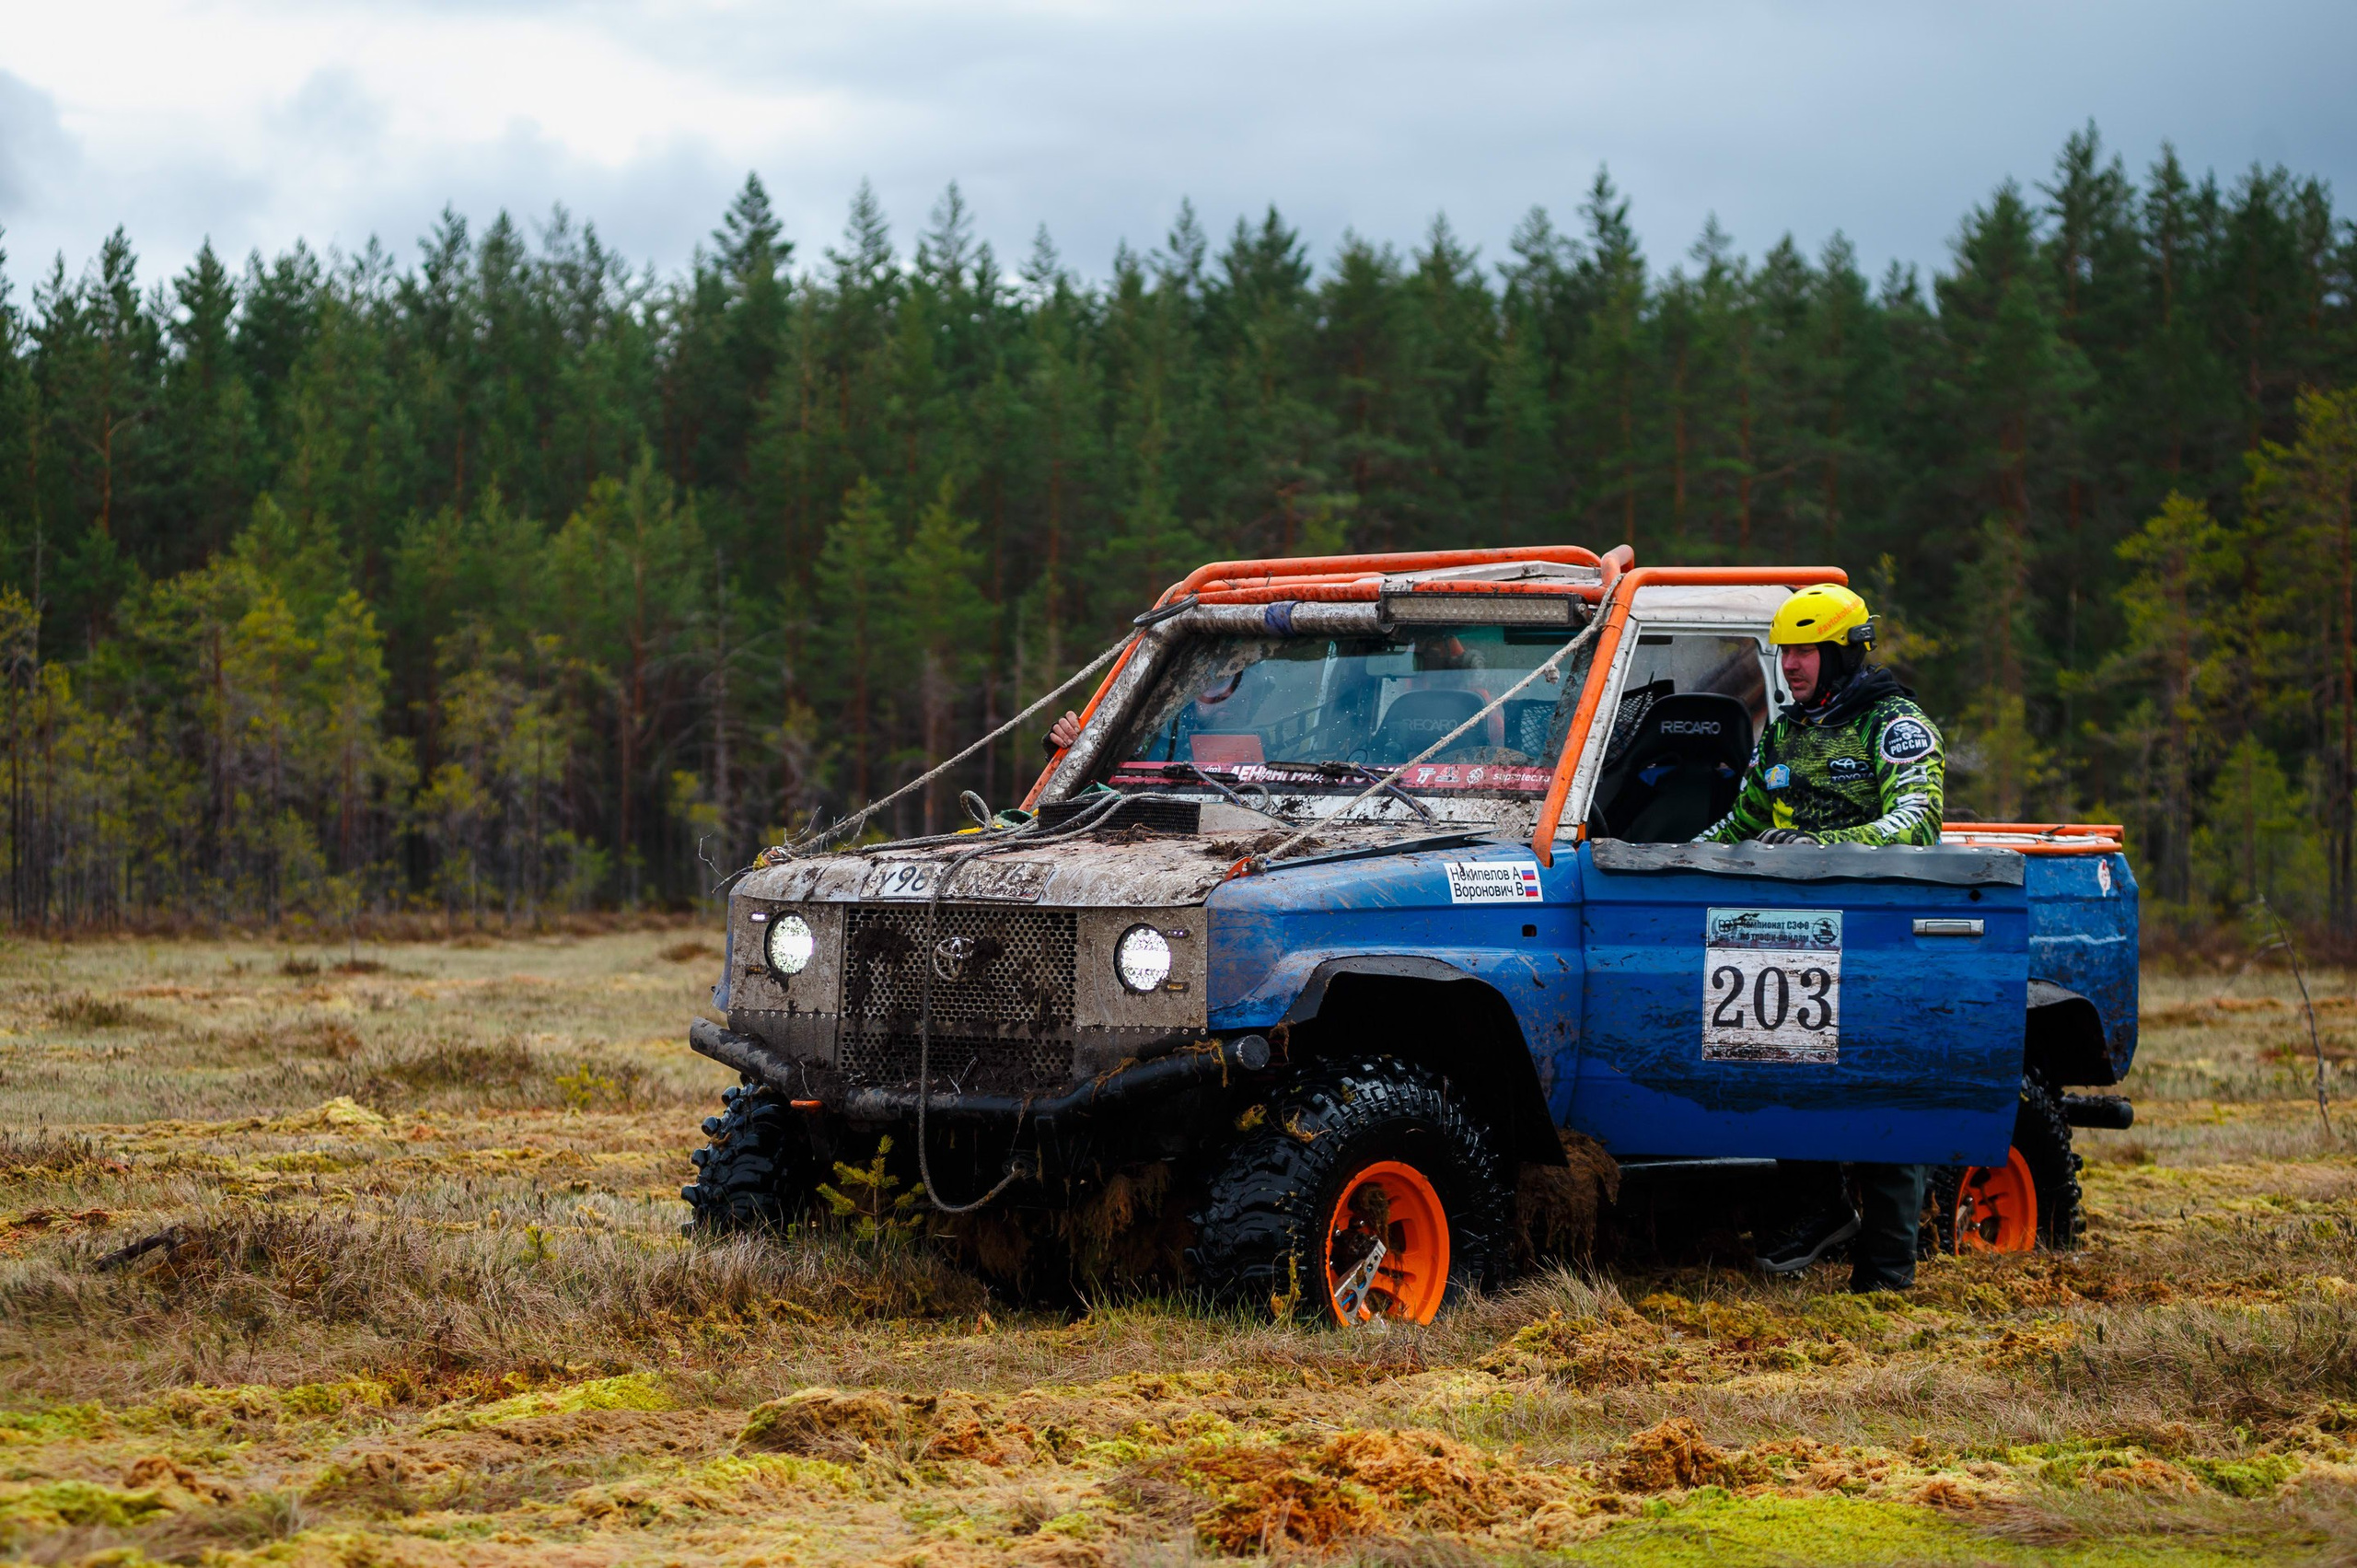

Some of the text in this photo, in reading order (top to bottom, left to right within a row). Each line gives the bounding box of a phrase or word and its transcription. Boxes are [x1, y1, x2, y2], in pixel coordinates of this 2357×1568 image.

[1661, 721, 1721, 734] RECARO
[1890, 739, 1928, 755] РОССИИ
[1831, 772, 1875, 783] TOYOTA
[1450, 866, 1522, 881] Некипелов А
[1454, 882, 1525, 900] Воронович В
[1712, 965, 1833, 1031] 203
